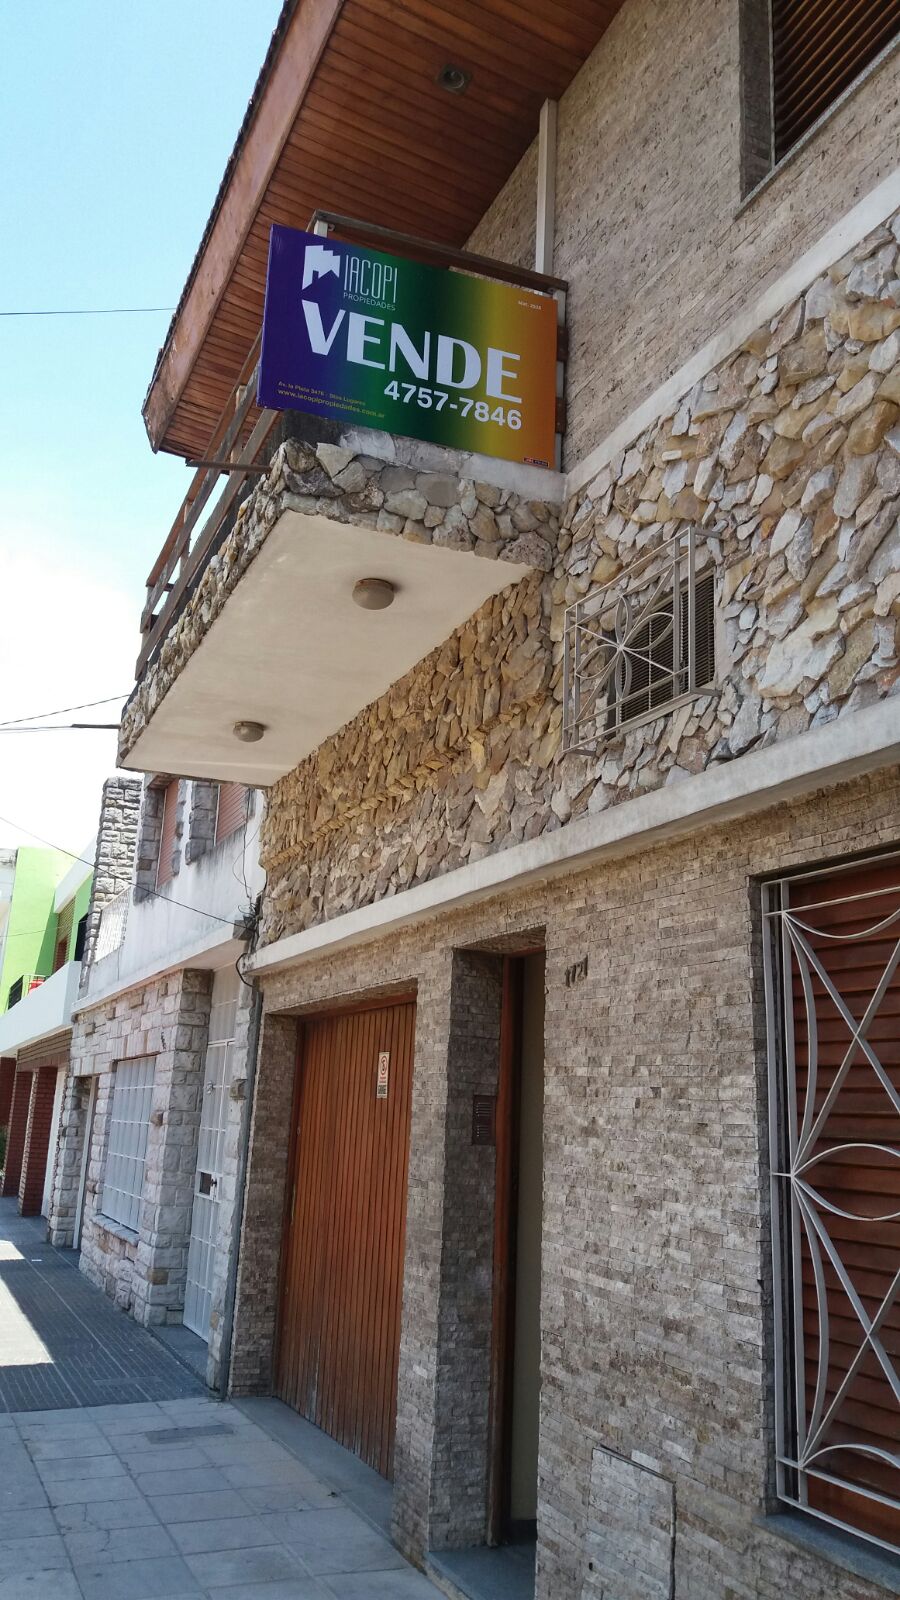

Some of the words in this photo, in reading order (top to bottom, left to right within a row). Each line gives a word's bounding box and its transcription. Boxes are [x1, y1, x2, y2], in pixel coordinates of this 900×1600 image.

[343, 254, 398, 304] IACOPI
[343, 291, 396, 312] PROPIEDADES
[301, 299, 522, 404] VENDE
[383, 380, 523, 431] 4757-7846
